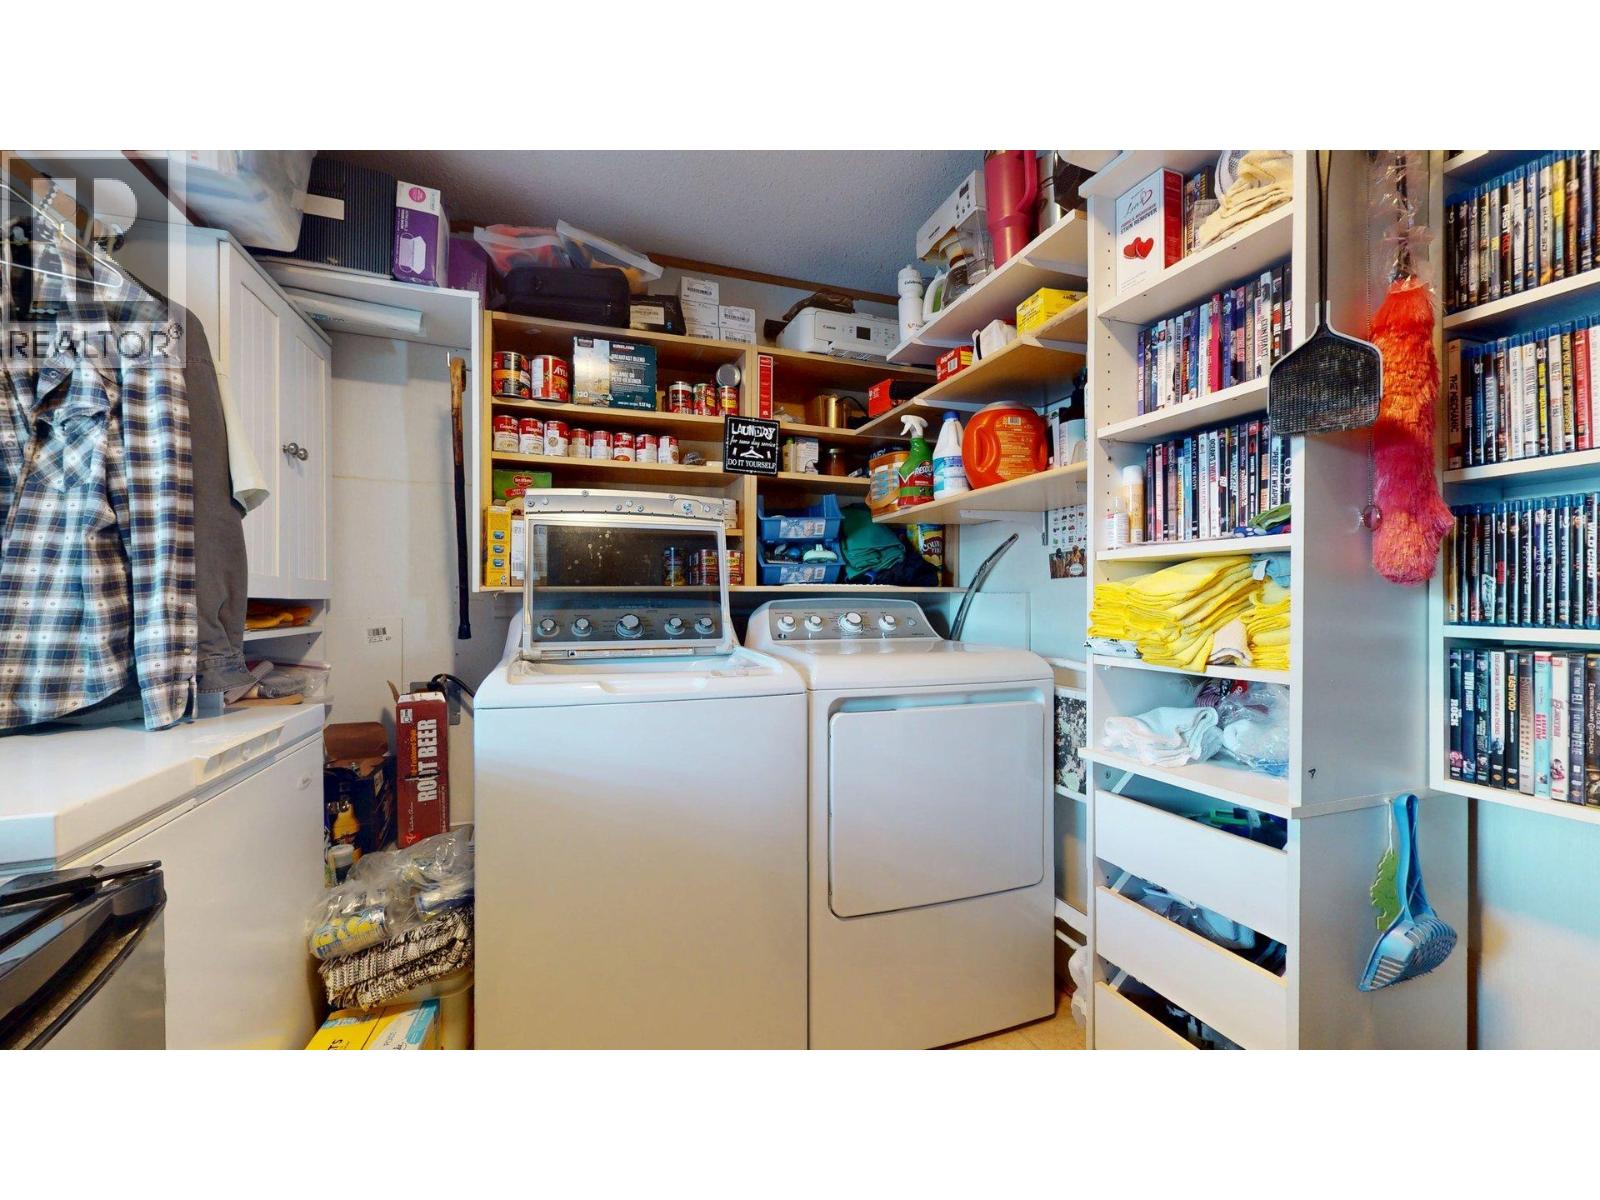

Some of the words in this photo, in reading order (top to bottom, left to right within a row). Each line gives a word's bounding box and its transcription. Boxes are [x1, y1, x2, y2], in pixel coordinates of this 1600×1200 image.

[1485, 377, 1494, 438] MARAUDERS
[729, 435, 737, 446] for
[751, 438, 760, 448] day
[731, 423, 776, 440] LAUNDRY
[728, 458, 737, 466] DO
[746, 460, 777, 469] YOURSELF
[1271, 452, 1280, 478] PERFECT
[1284, 457, 1293, 492] CODE
[1272, 479, 1280, 505] WEAPON
[1508, 675, 1516, 711] EASTWOOD
[1572, 694, 1581, 705] ELI
[1450, 699, 1459, 726] ROCK
[417, 719, 437, 758] BEER
